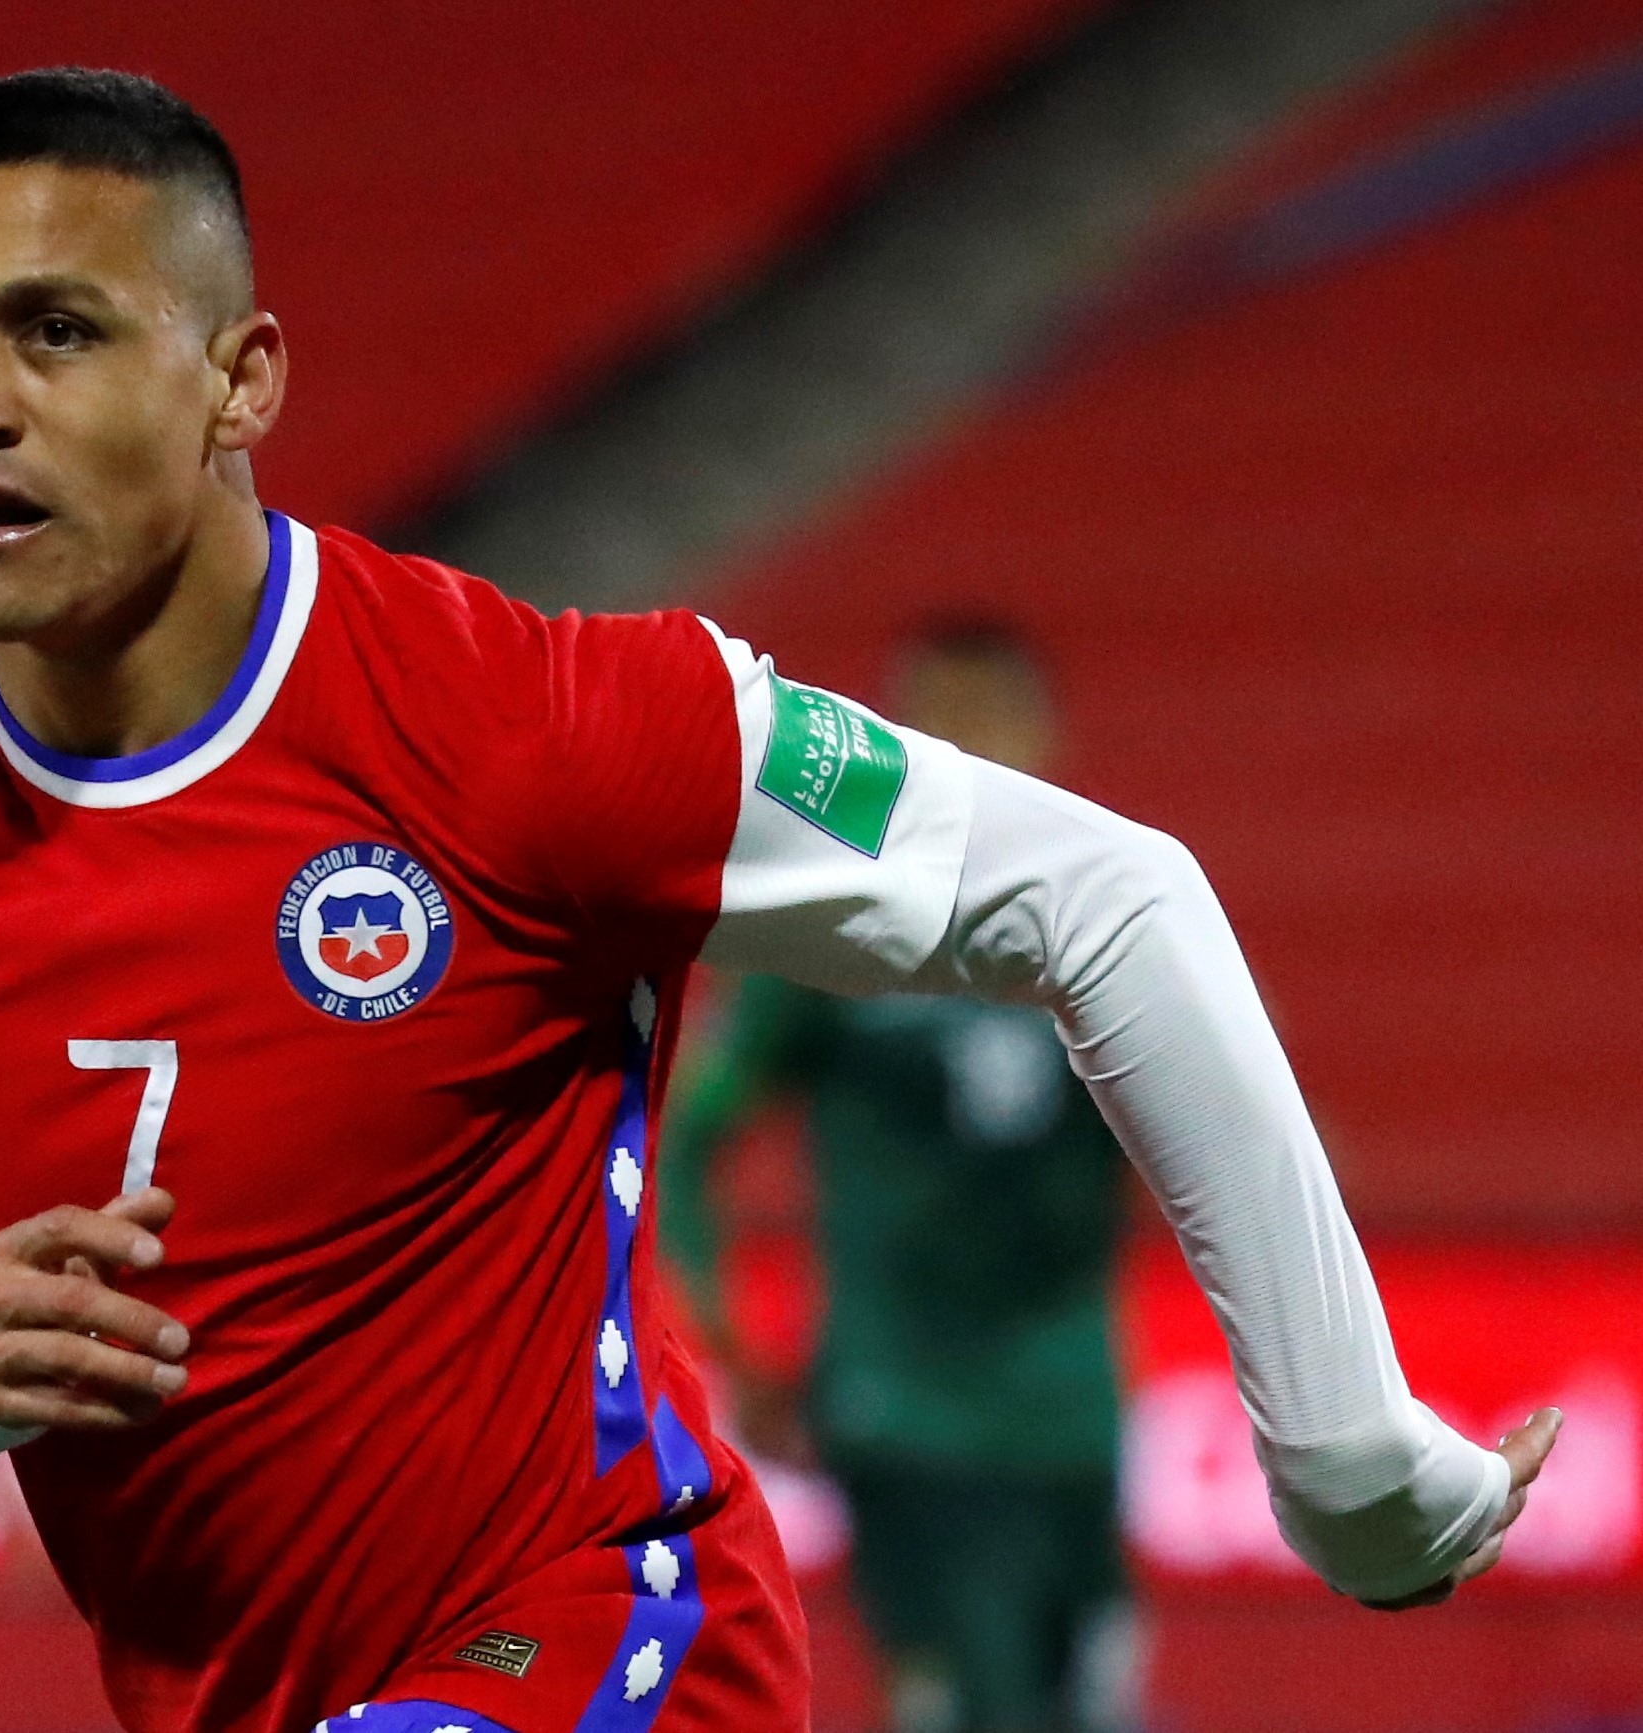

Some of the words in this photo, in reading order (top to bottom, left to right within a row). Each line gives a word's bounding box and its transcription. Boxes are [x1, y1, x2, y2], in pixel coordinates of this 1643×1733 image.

[793, 694, 824, 801] LIVING
[279, 845, 357, 939] FEDERACION
[371, 846, 396, 869] DE
[400, 861, 450, 931] FUTBOL
[68, 1039, 179, 1196] 7
